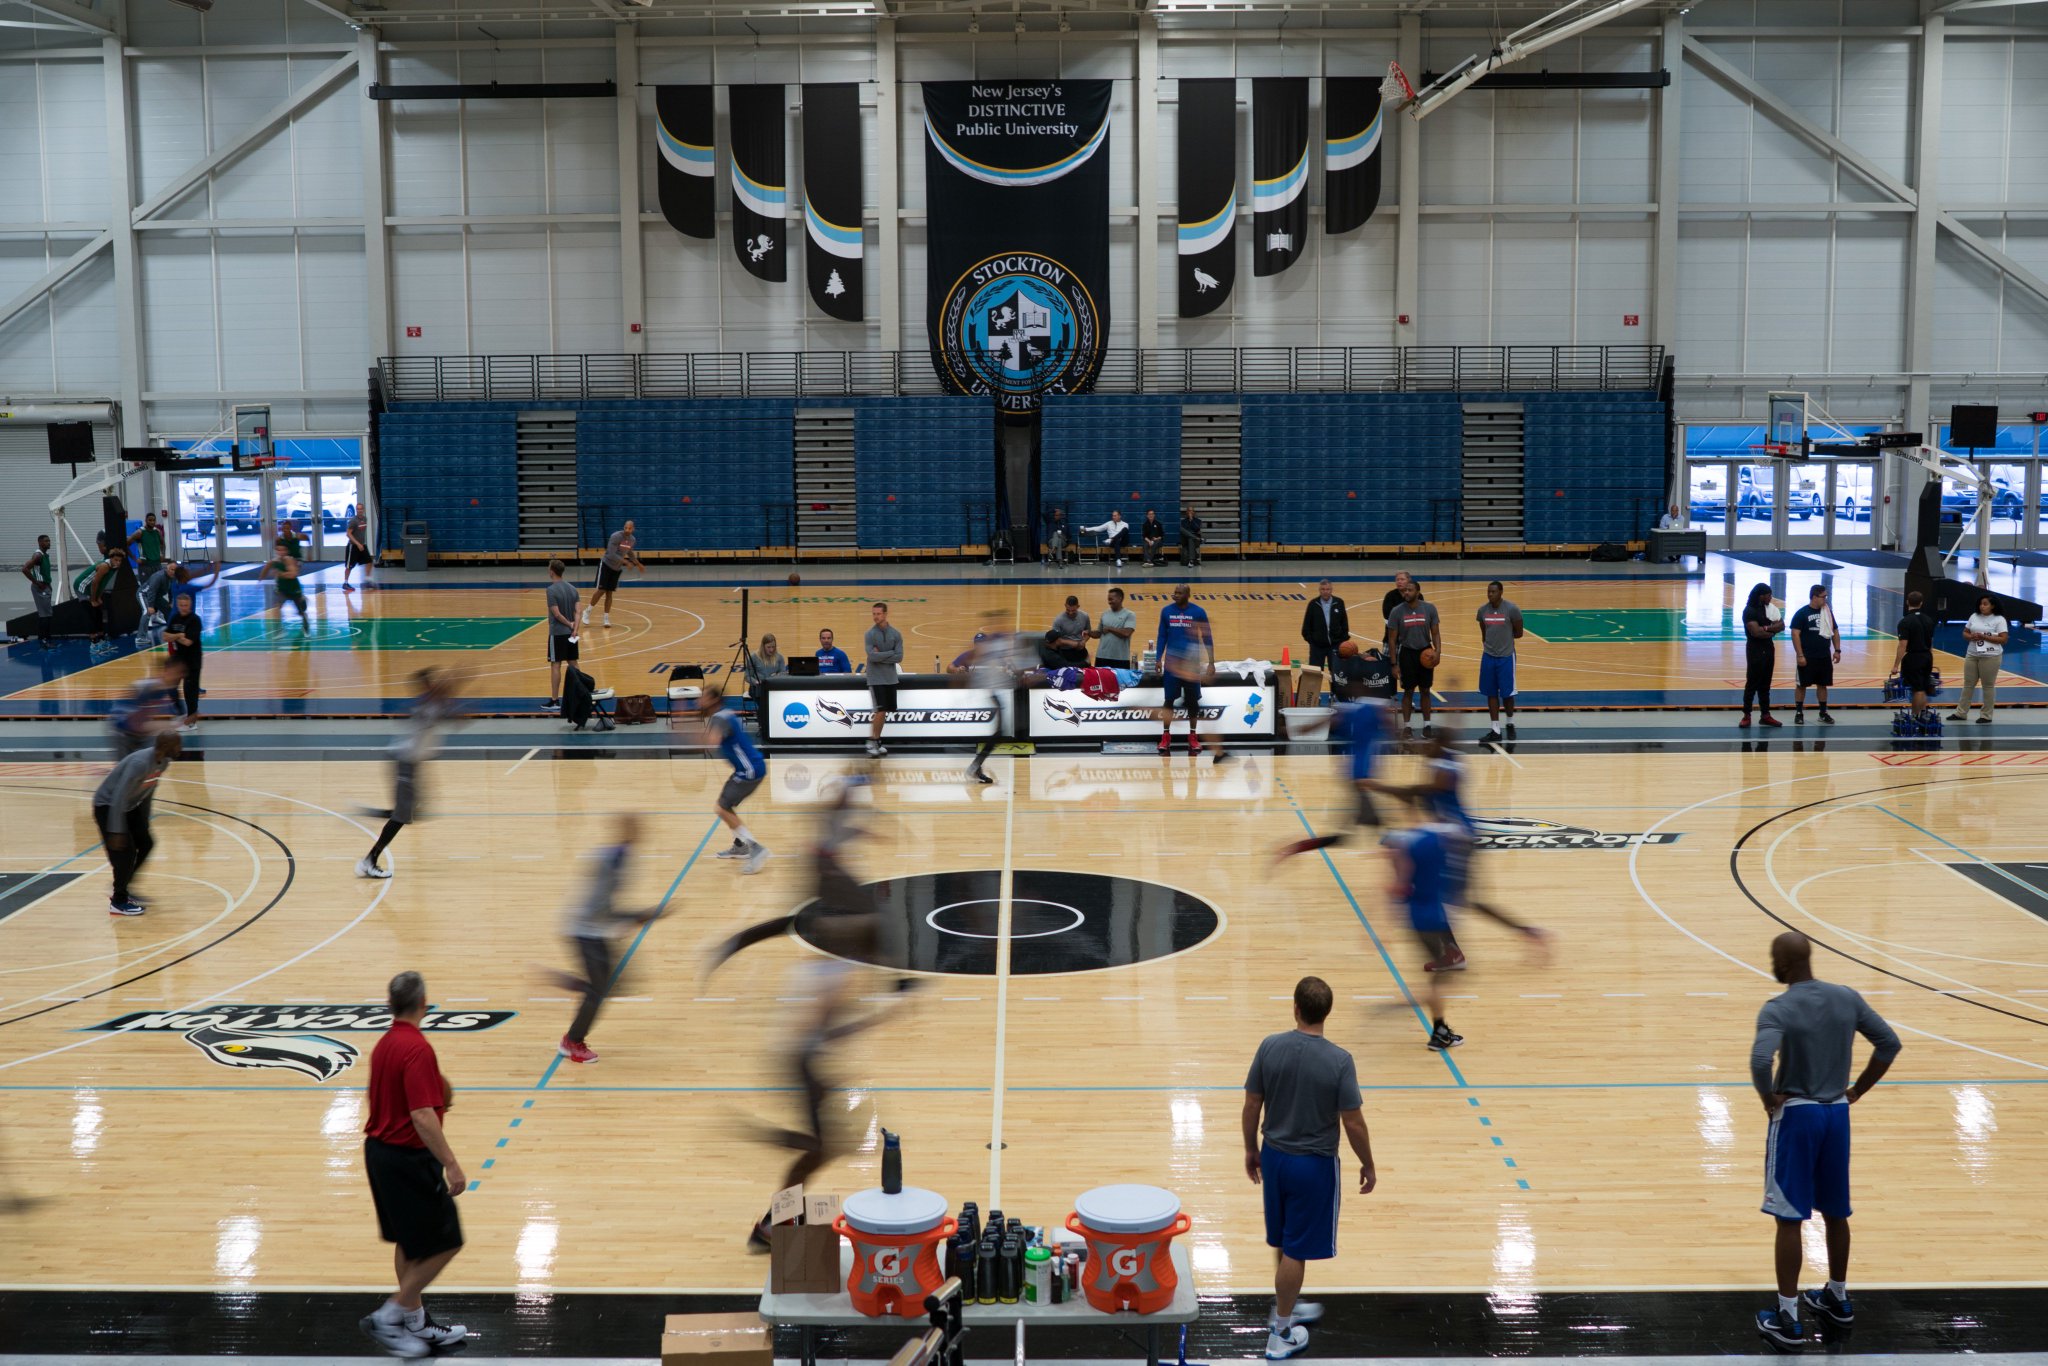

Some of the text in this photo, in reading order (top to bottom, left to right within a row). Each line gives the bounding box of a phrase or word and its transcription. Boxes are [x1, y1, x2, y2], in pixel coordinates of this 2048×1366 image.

[972, 84, 1062, 100] New Jersey's
[968, 104, 1066, 117] DISTINCTIVE
[956, 122, 1079, 138] Public University
[972, 256, 1066, 285] STOCKTON
[785, 714, 809, 723] NCAA
[852, 710, 991, 722] STOKTON OSPREYS
[1079, 708, 1152, 720] STOCKTON
[1473, 834, 1665, 844] OCKTON
[213, 1005, 389, 1014] SPREYS
